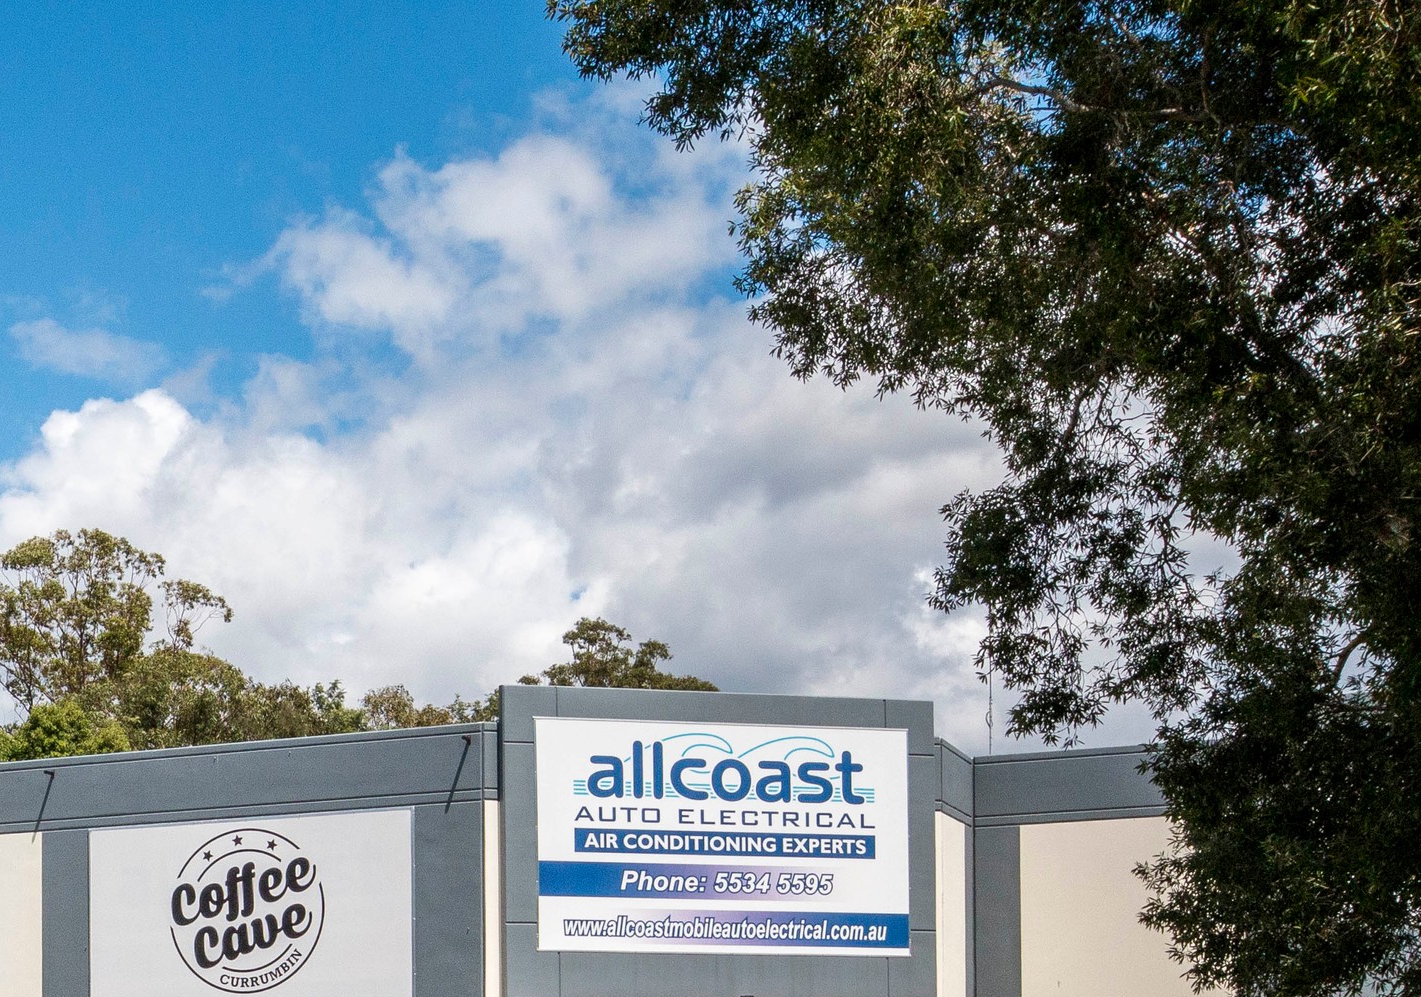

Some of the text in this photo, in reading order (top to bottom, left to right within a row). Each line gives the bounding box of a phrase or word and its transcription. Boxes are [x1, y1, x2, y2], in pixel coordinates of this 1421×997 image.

[587, 740, 865, 805] allcoast
[575, 806, 876, 829] AUTO ELECTRICAL
[584, 833, 867, 855] AIR CONDITIONING EXPERTS
[172, 857, 316, 926] Coffee
[621, 869, 834, 896] Phone: 5534 5595
[194, 903, 312, 969] Cave
[563, 915, 886, 942] www.allcoastmobileautoelectrical.com.au
[220, 949, 302, 987] CURRUMBIN
